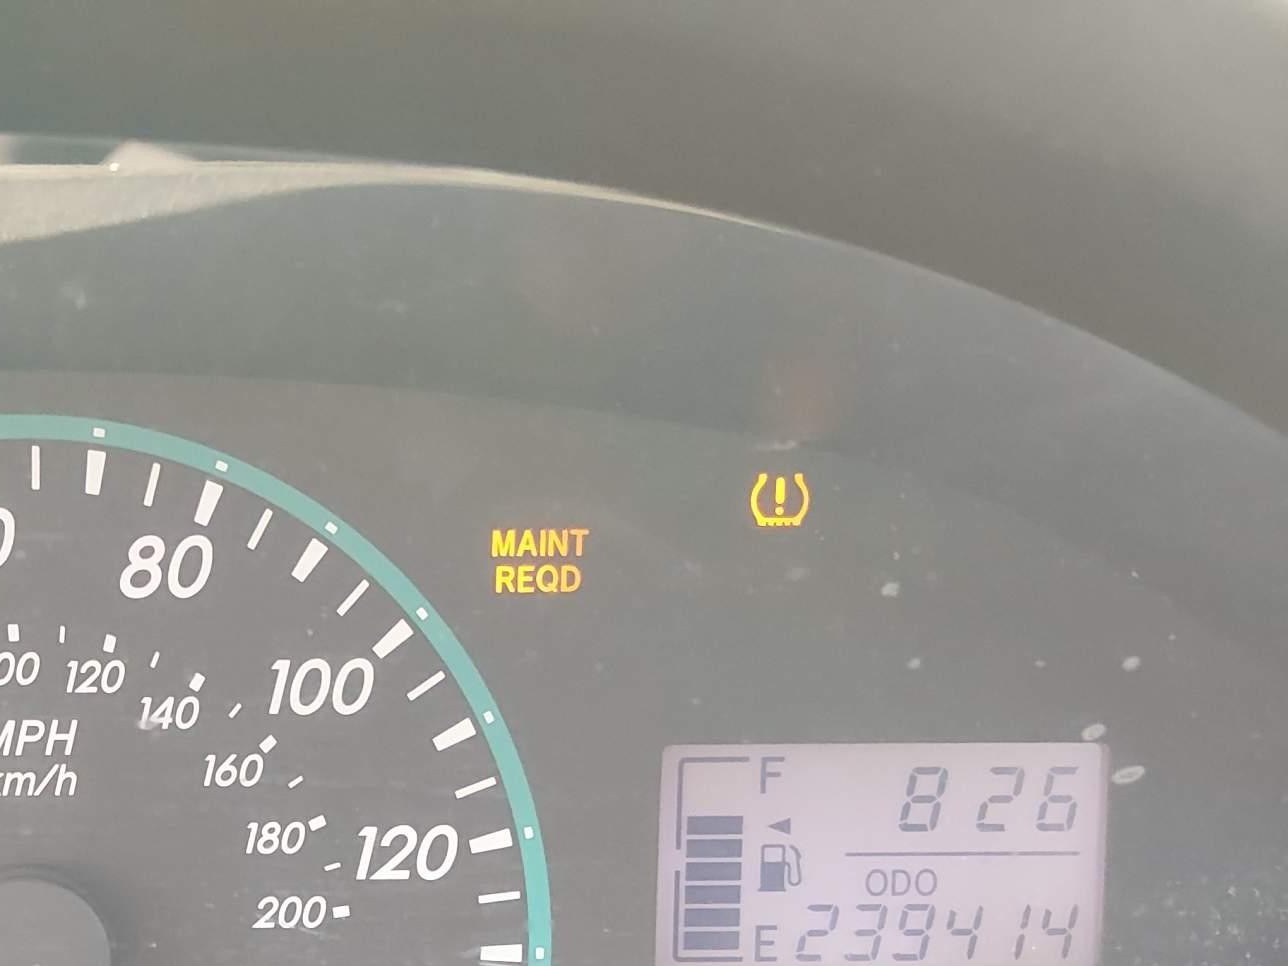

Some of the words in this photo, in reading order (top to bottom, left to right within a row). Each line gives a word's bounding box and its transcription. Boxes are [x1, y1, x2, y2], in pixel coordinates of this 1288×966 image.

[491, 529, 589, 557] MAINT
[119, 535, 213, 599] 80
[494, 565, 581, 593] REQD
[64, 660, 125, 694] 120
[268, 658, 375, 716] 100
[139, 696, 200, 730] 140
[202, 754, 264, 788] 160
[760, 757, 785, 794] F
[245, 822, 305, 855] 180
[355, 824, 458, 881] 120
[865, 869, 937, 896] ODO
[251, 897, 327, 929] 200
[754, 925, 778, 962] E
[795, 904, 1078, 961] 239414
